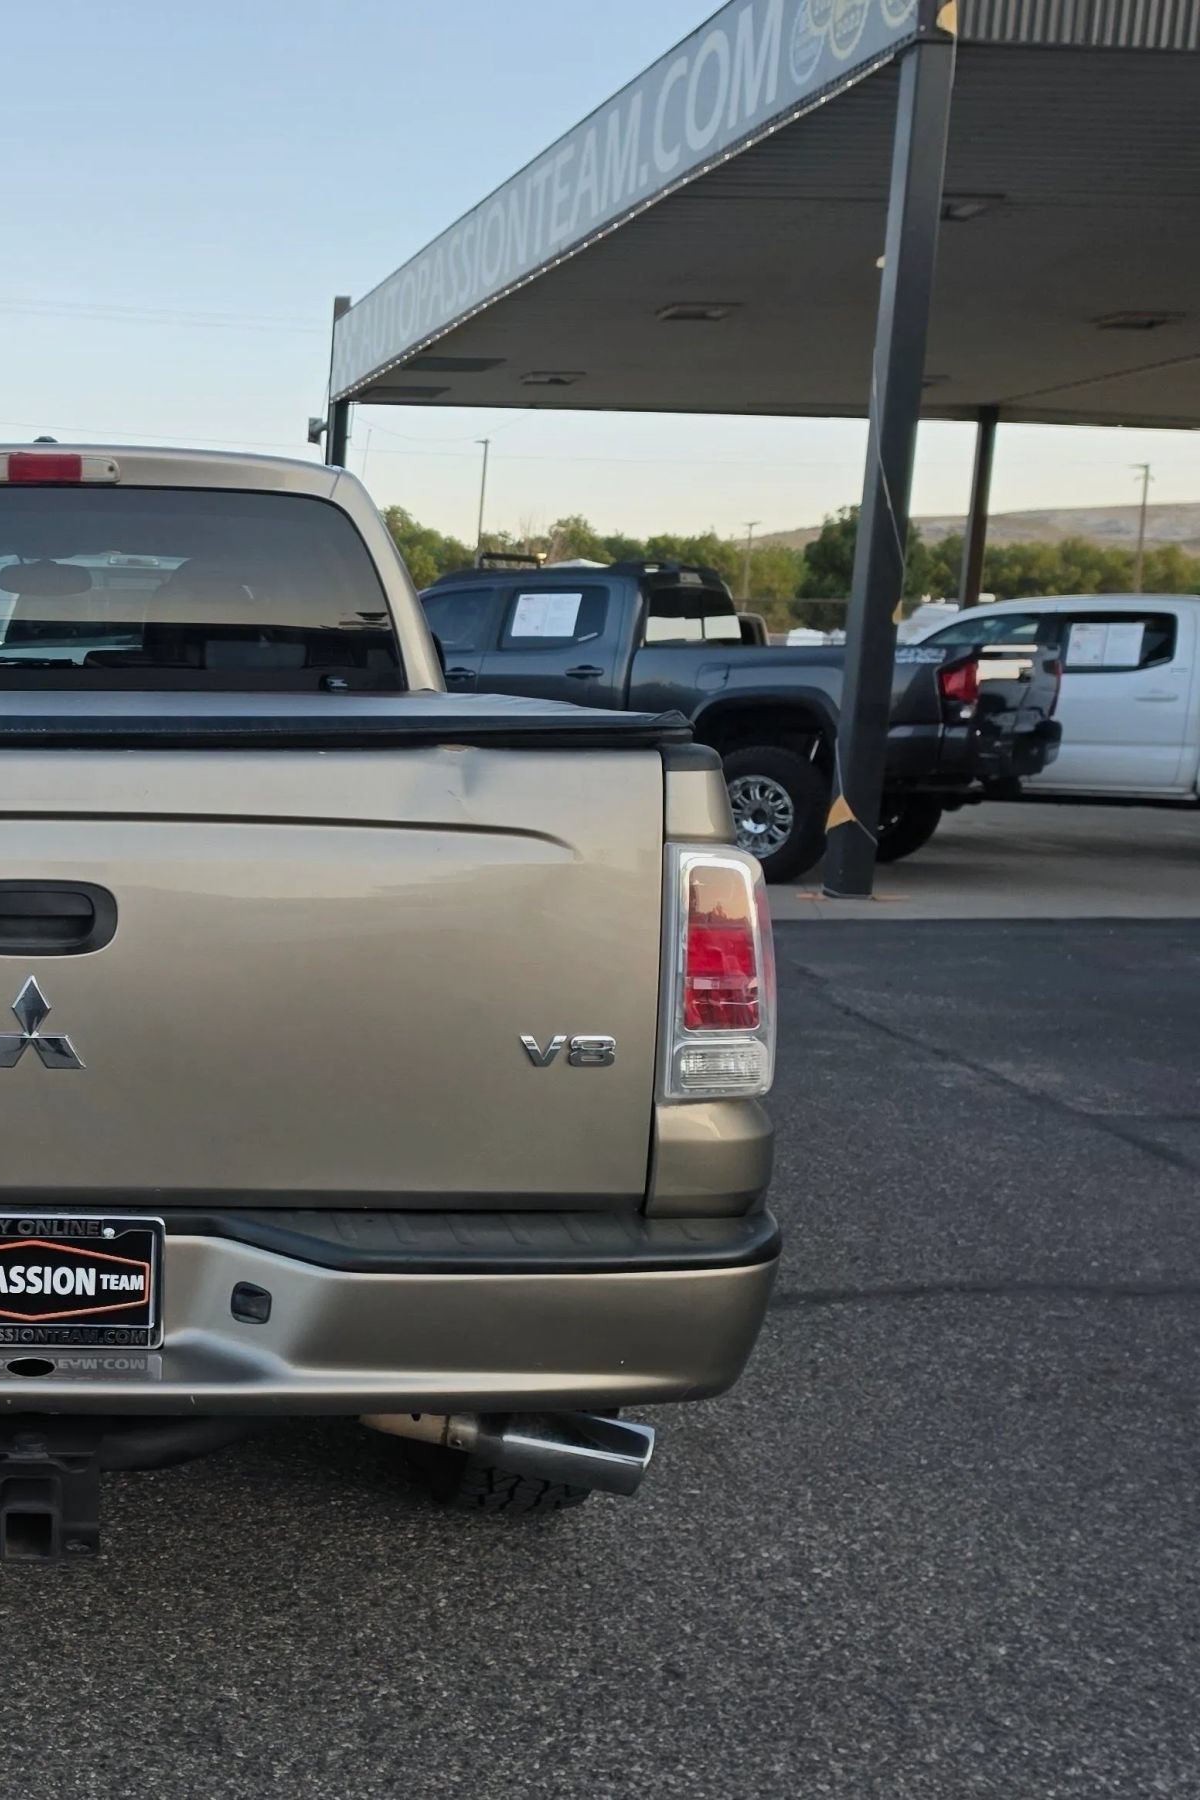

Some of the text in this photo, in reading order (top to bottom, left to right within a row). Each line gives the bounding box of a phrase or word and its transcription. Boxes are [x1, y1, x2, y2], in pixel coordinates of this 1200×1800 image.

[520, 1035, 616, 1067] V8
[17, 1219, 101, 1237] ONLINE
[100, 1274, 144, 1291] TEAM
